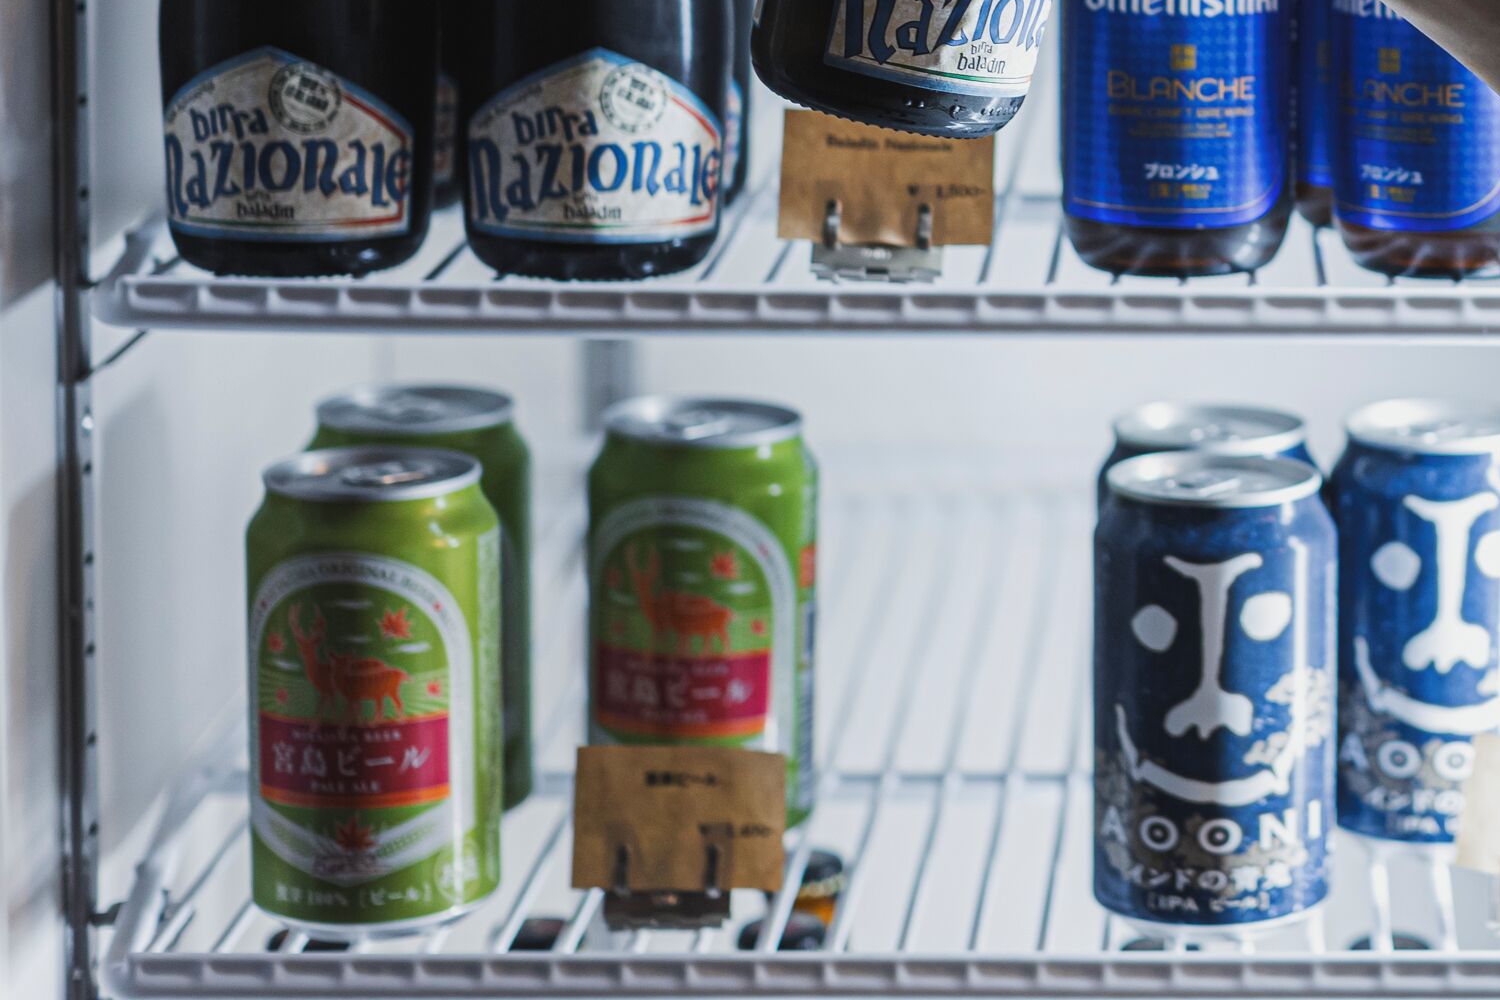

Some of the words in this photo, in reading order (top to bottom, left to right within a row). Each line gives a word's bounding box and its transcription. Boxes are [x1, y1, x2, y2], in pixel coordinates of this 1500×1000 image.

[956, 52, 1007, 75] baladin
[970, 41, 994, 56] birra
[1107, 70, 1256, 101] BLANCHE
[189, 101, 269, 142] birra
[511, 104, 600, 146] birra
[1101, 798, 1322, 855] AOONI
